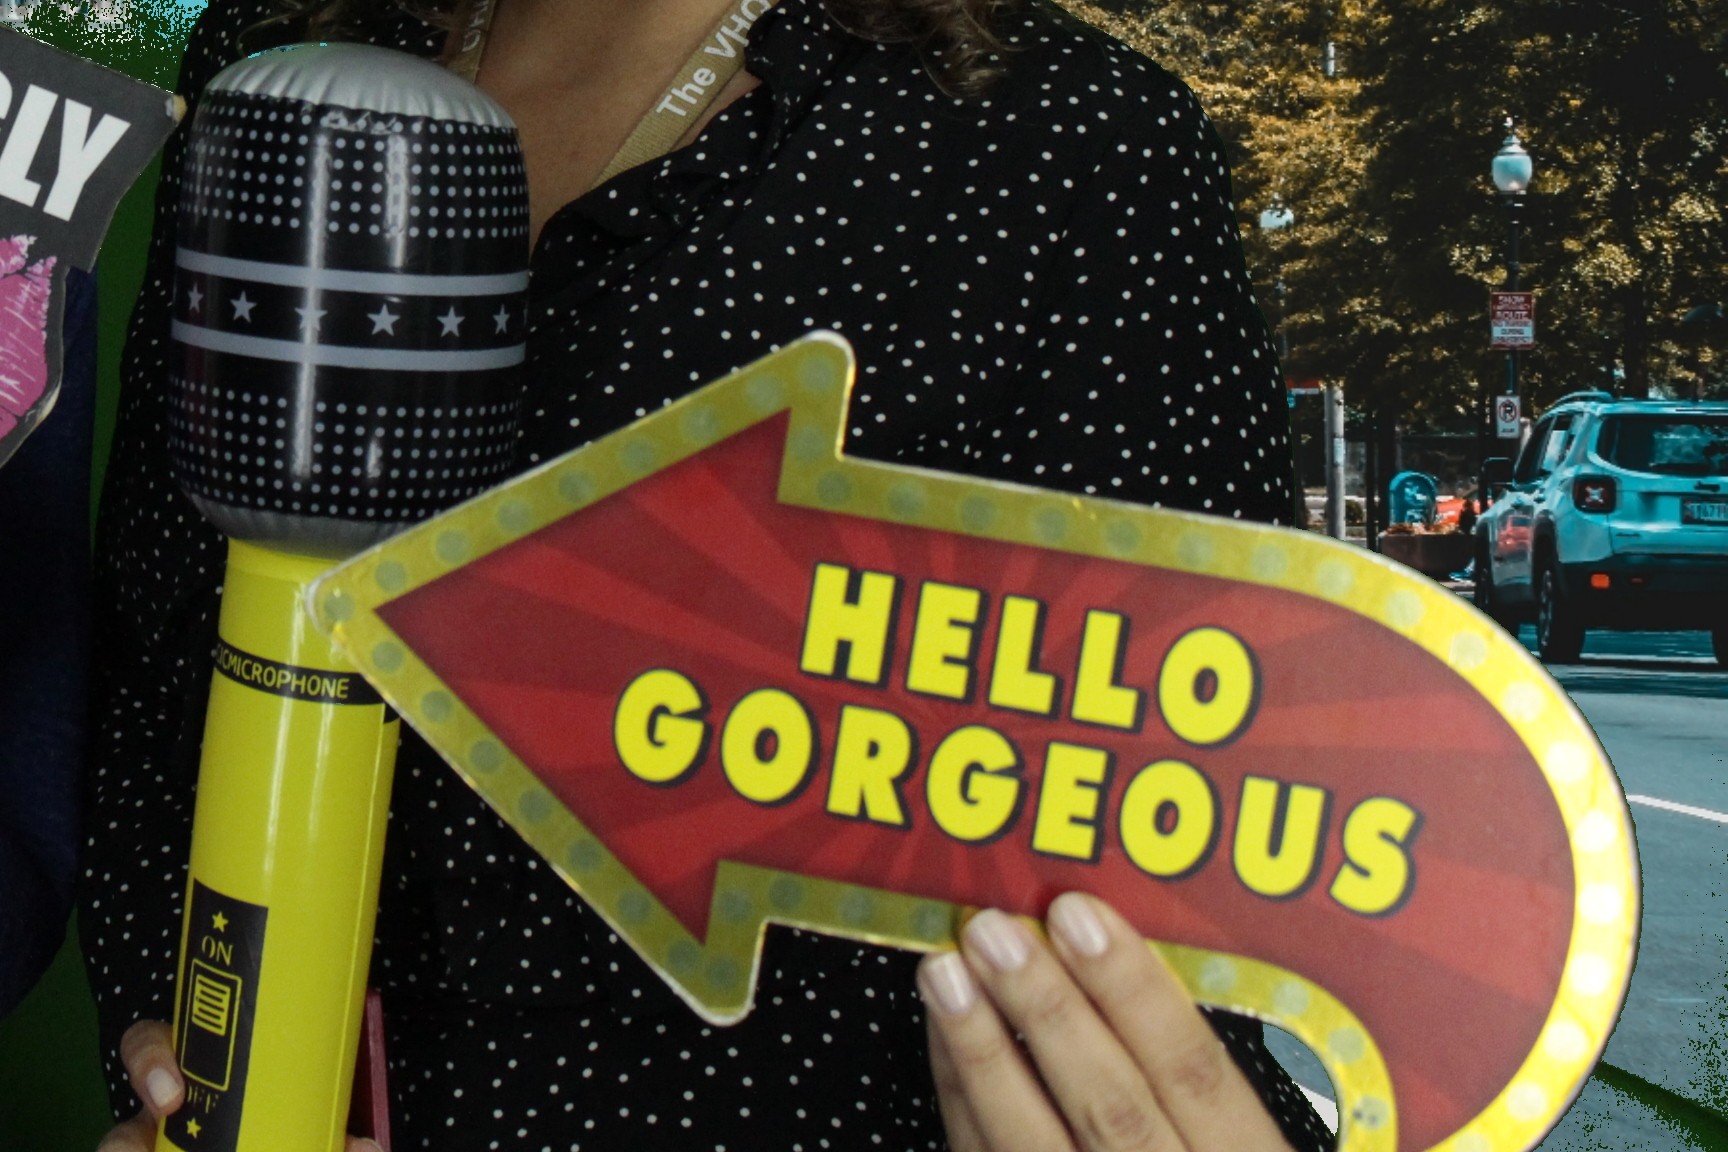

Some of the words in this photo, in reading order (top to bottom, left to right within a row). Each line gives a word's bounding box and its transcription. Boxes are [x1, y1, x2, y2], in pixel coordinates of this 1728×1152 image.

[655, 67, 717, 117] The
[800, 563, 1257, 746] HELLO
[613, 669, 1420, 917] GORGEOUS
[201, 935, 234, 967] ON
